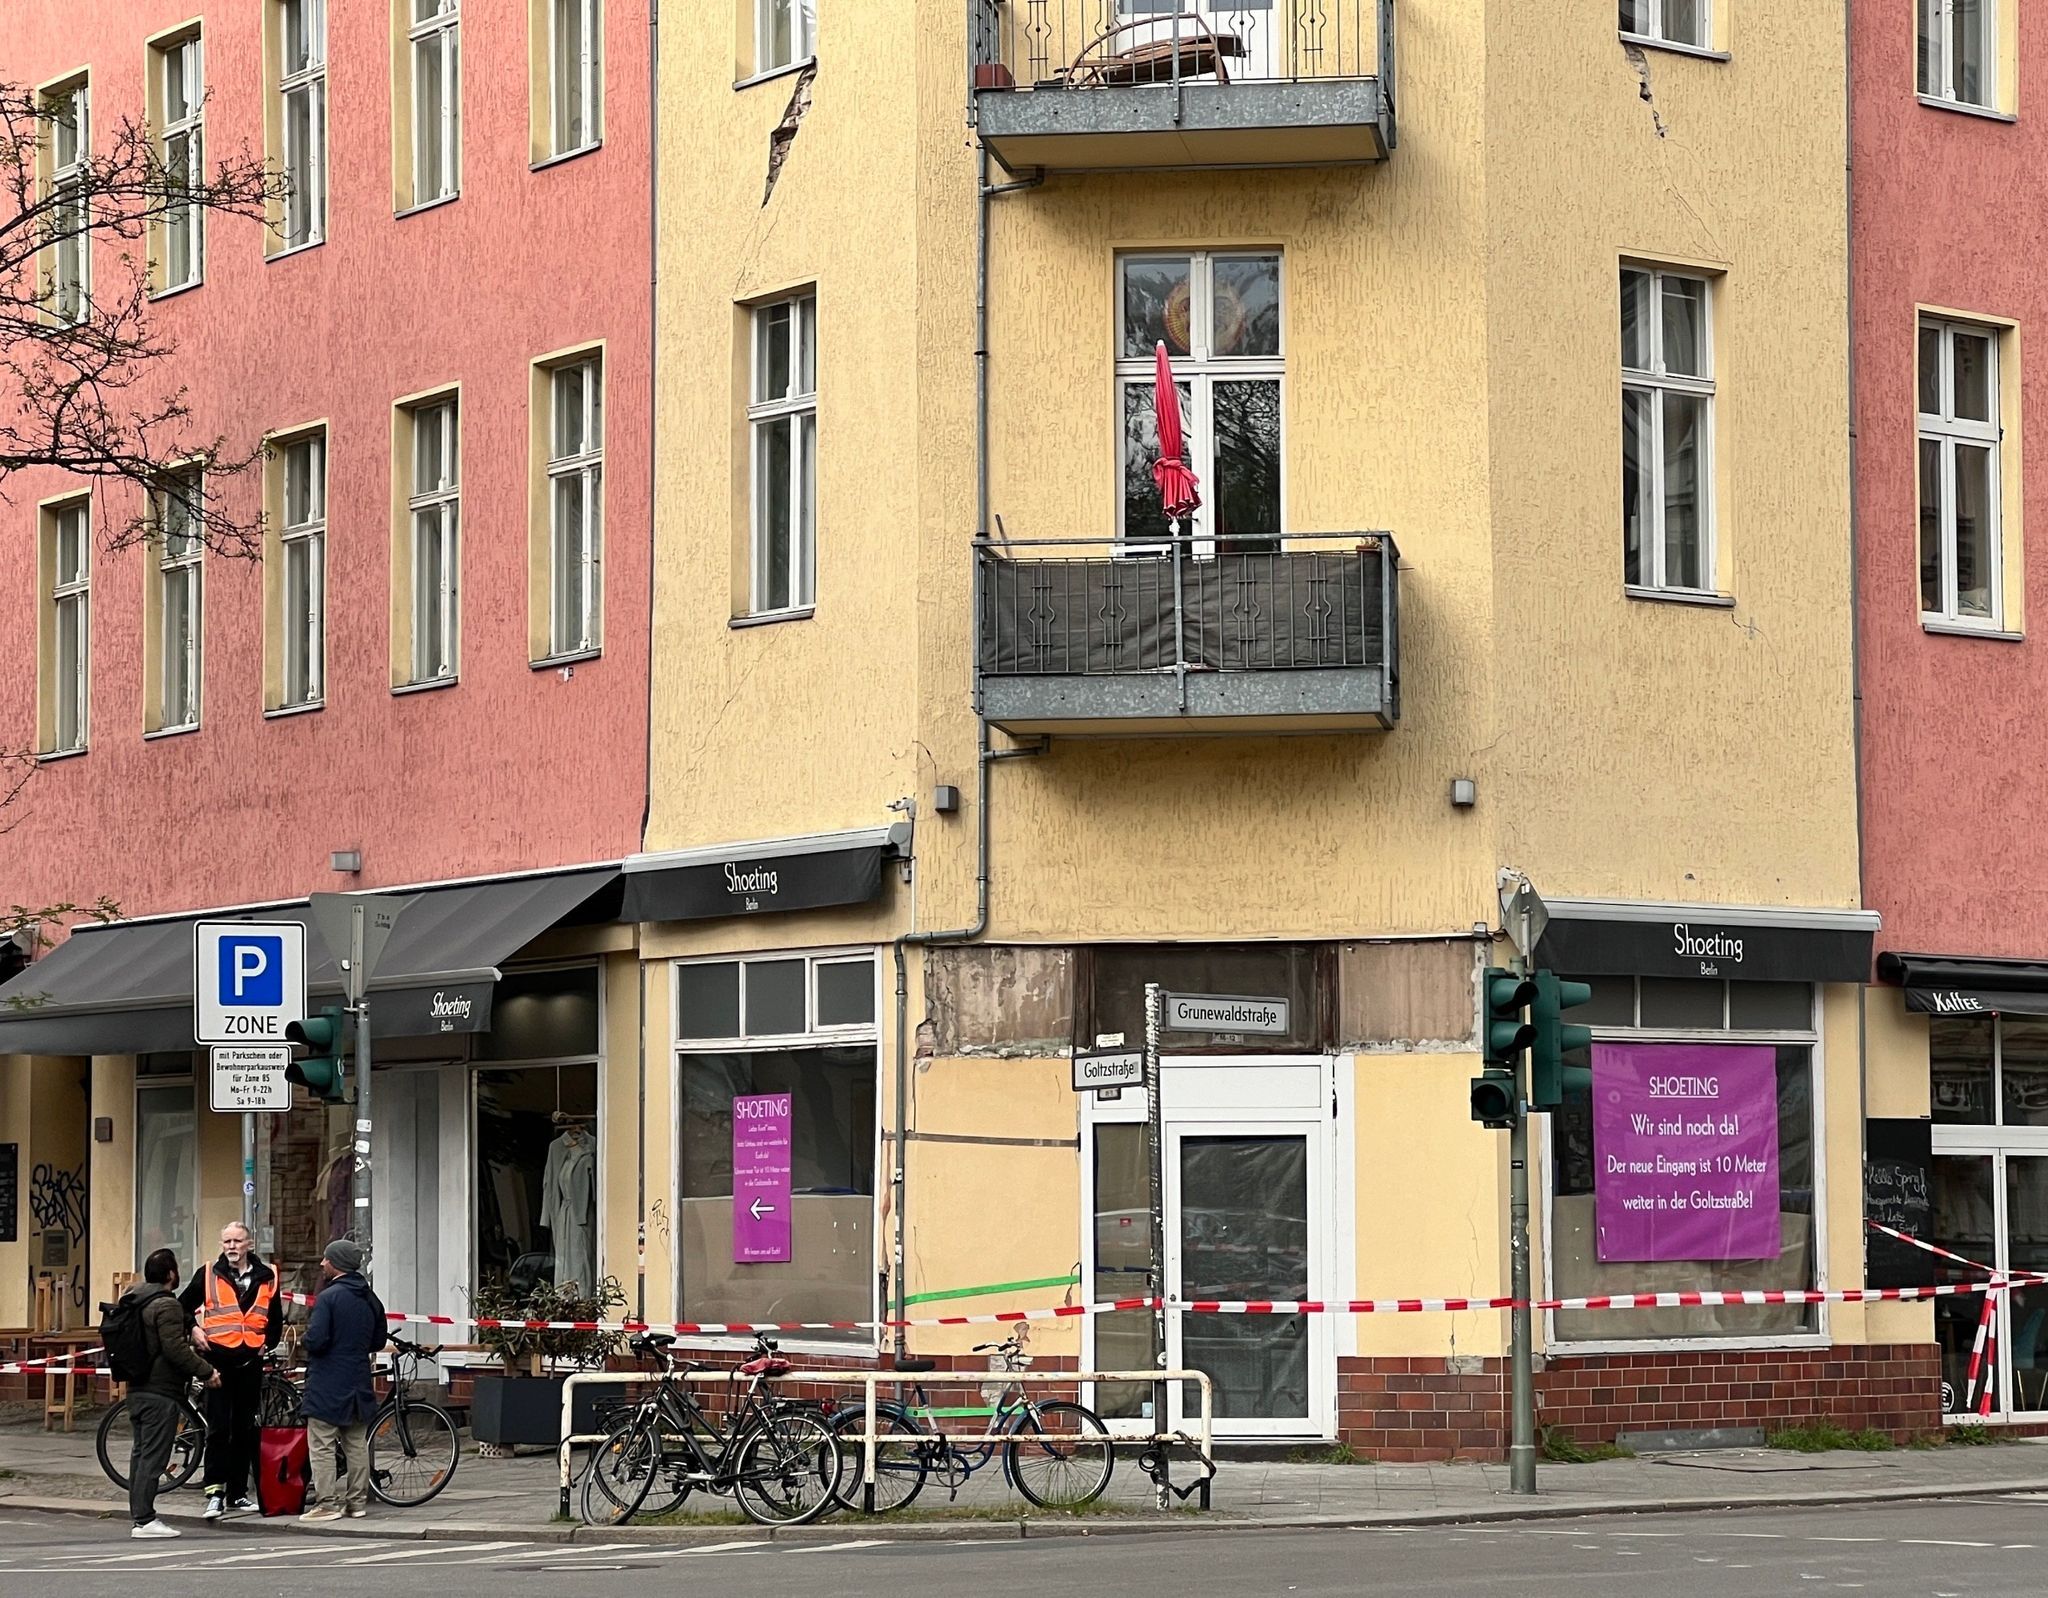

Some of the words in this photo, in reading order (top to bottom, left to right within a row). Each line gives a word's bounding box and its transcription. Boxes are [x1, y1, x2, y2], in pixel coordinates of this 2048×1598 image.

[724, 862, 778, 895] Shoeting
[1674, 923, 1743, 963] Shoeting
[234, 945, 268, 997] P
[1700, 961, 1718, 976] Berlin
[430, 991, 472, 1019] Shoeting
[1178, 1002, 1277, 1026] Grunewaldstraße
[224, 1015, 278, 1034] ZONE
[219, 1051, 230, 1060] mit
[232, 1051, 266, 1060] Parkschein
[268, 1051, 283, 1060] oder
[216, 1062, 286, 1072] Bewohnerparkausweis
[1084, 1058, 1135, 1079] Goltzstraße
[232, 1073, 242, 1082] für
[244, 1073, 260, 1082] Zone
[1649, 1076, 1719, 1096] SHOETING
[230, 1085, 250, 1094] Mo-Fr
[236, 1097, 245, 1105] Sa
[736, 1098, 788, 1119] SHOETING
[1630, 1113, 1654, 1136] Wir
[1658, 1114, 1682, 1136] sind
[1686, 1114, 1715, 1136] noch
[1719, 1114, 1739, 1136] da!
[1607, 1154, 1626, 1173] Der
[1630, 1159, 1653, 1173] neue
[1656, 1154, 1697, 1176] Eingang
[1699, 1157, 1712, 1173] ist
[1716, 1156, 1732, 1173] 10
[1735, 1154, 1767, 1173] Meter
[1623, 1194, 1654, 1210] weiter
[1657, 1193, 1668, 1210] in
[1670, 1191, 1687, 1210] der
[1690, 1190, 1753, 1209] Goltzstraße!
